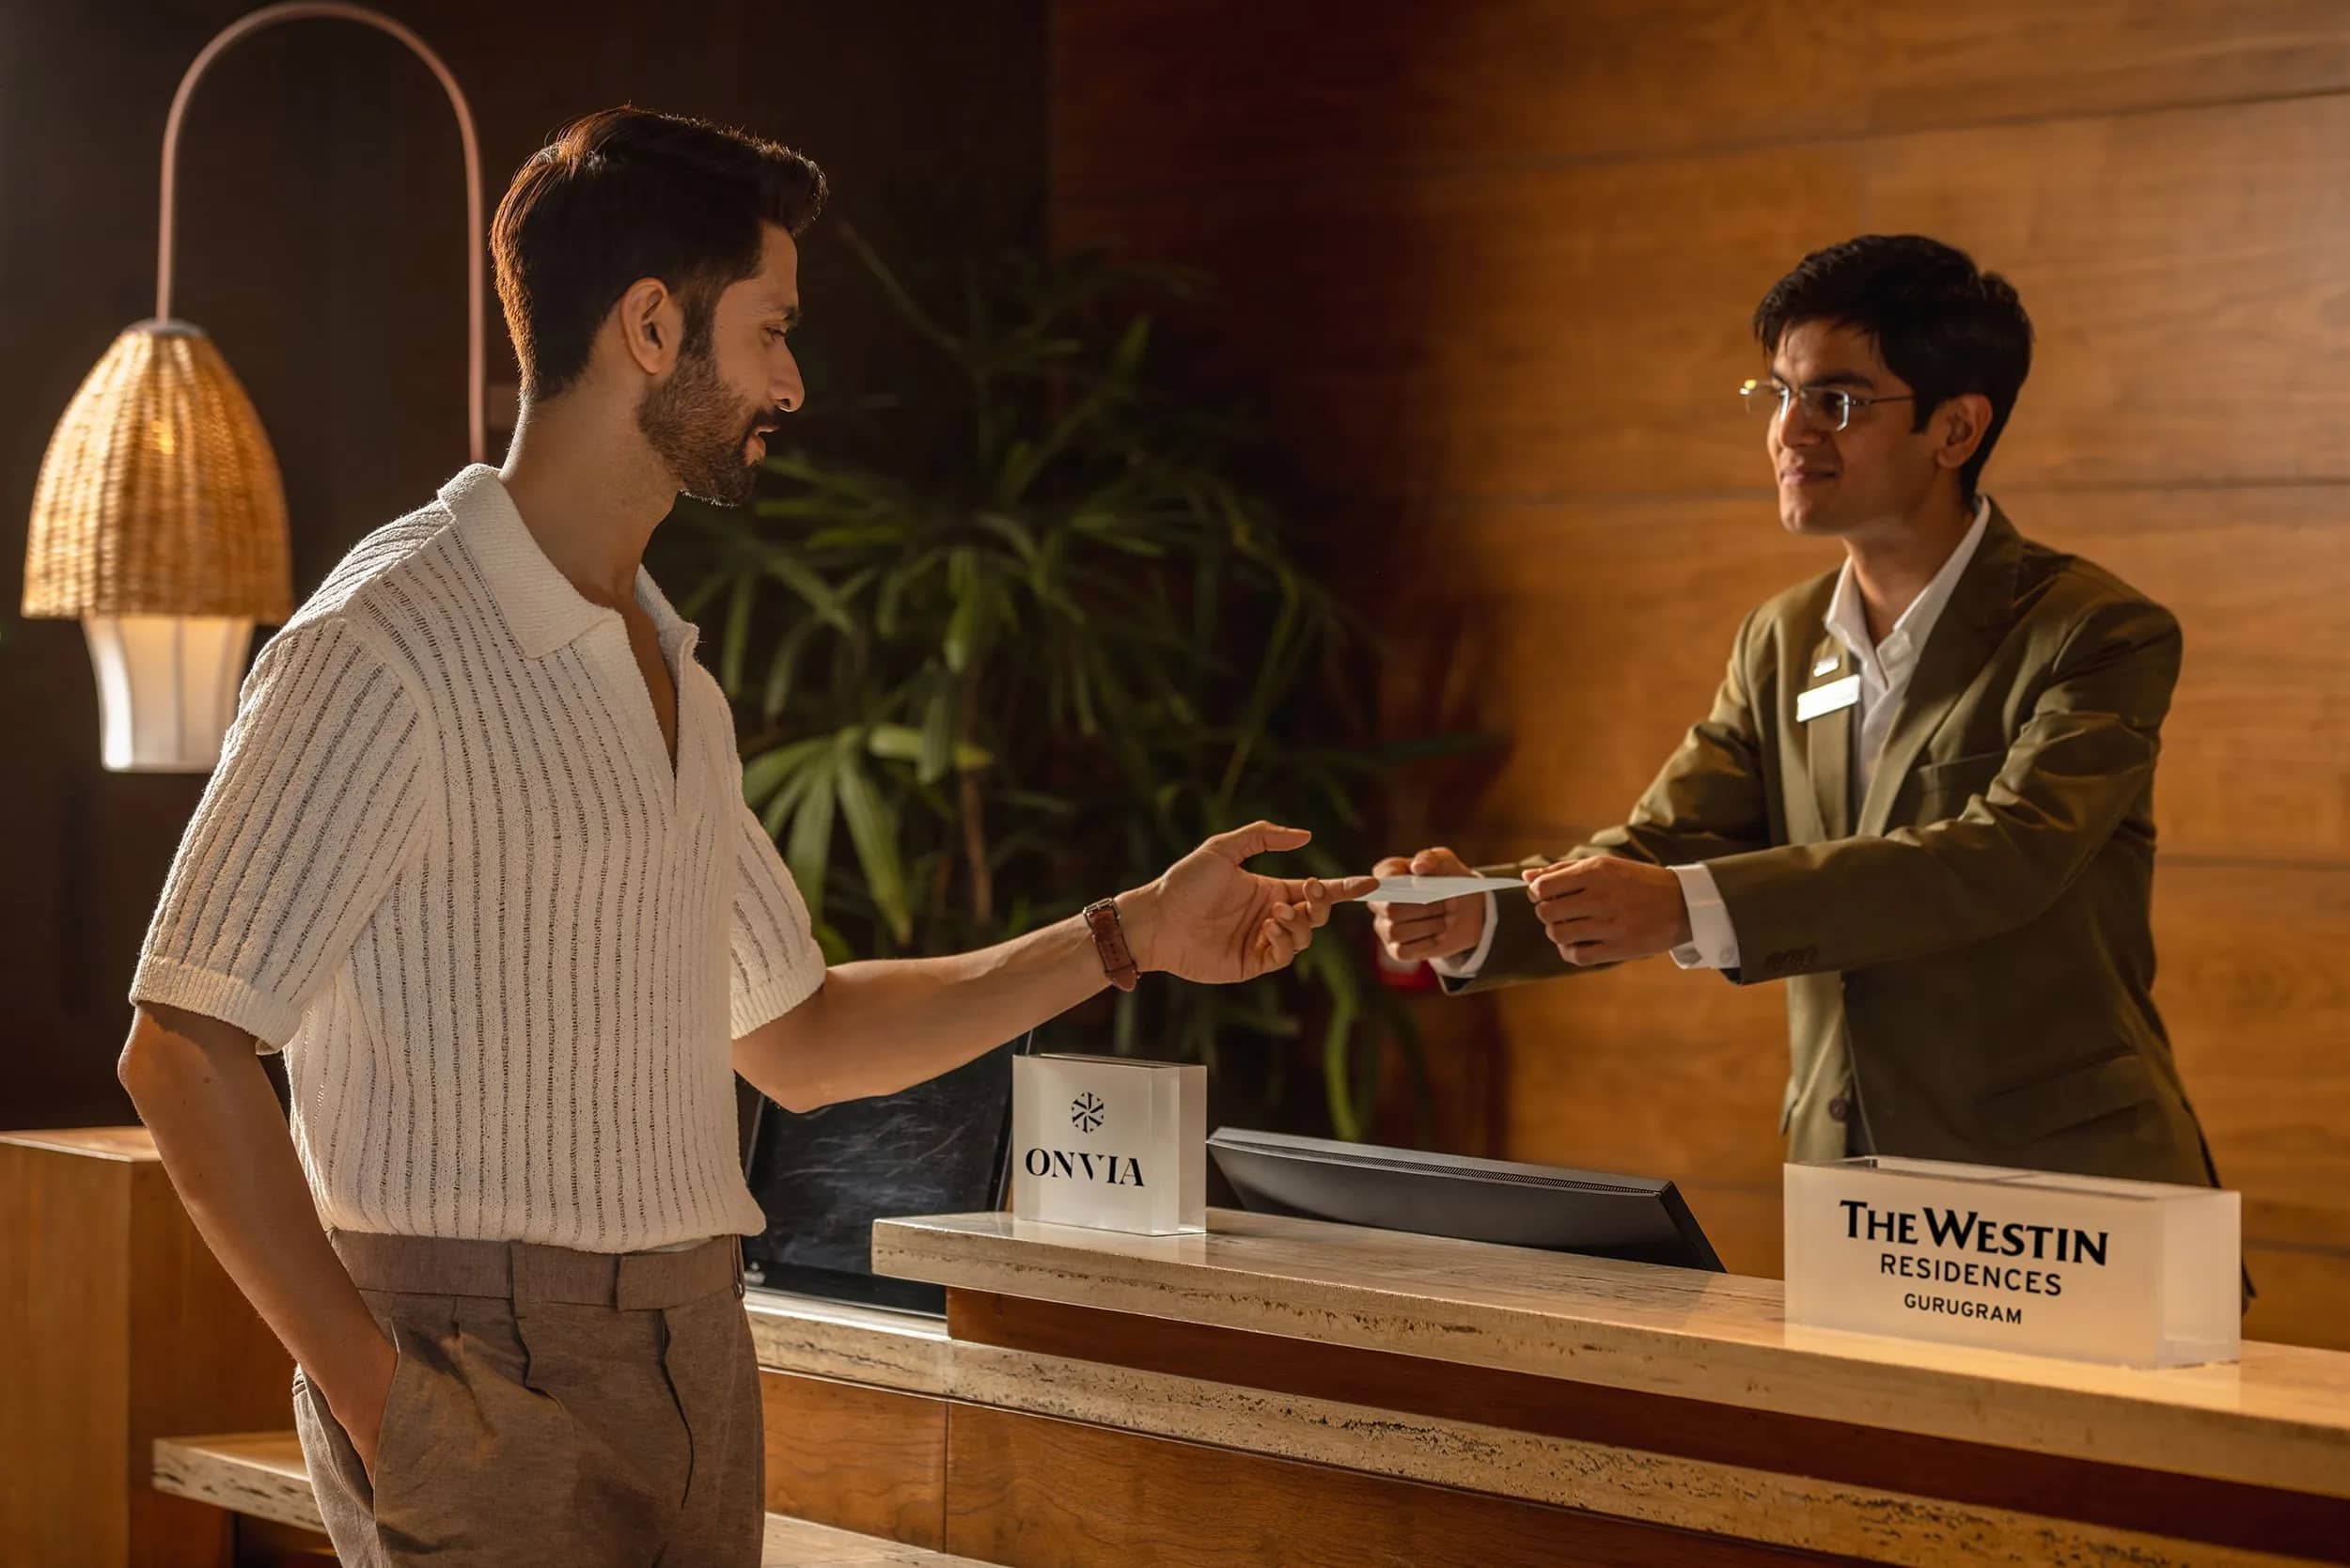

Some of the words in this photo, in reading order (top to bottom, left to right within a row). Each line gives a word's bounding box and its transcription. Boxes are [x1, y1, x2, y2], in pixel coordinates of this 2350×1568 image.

[1025, 1148, 1145, 1187] ONVIA
[1840, 1200, 1919, 1246] THE
[1922, 1207, 2108, 1266] WESTIN
[1880, 1253, 2062, 1296] RESIDENCES
[1904, 1293, 2022, 1325] GURUGRAM
